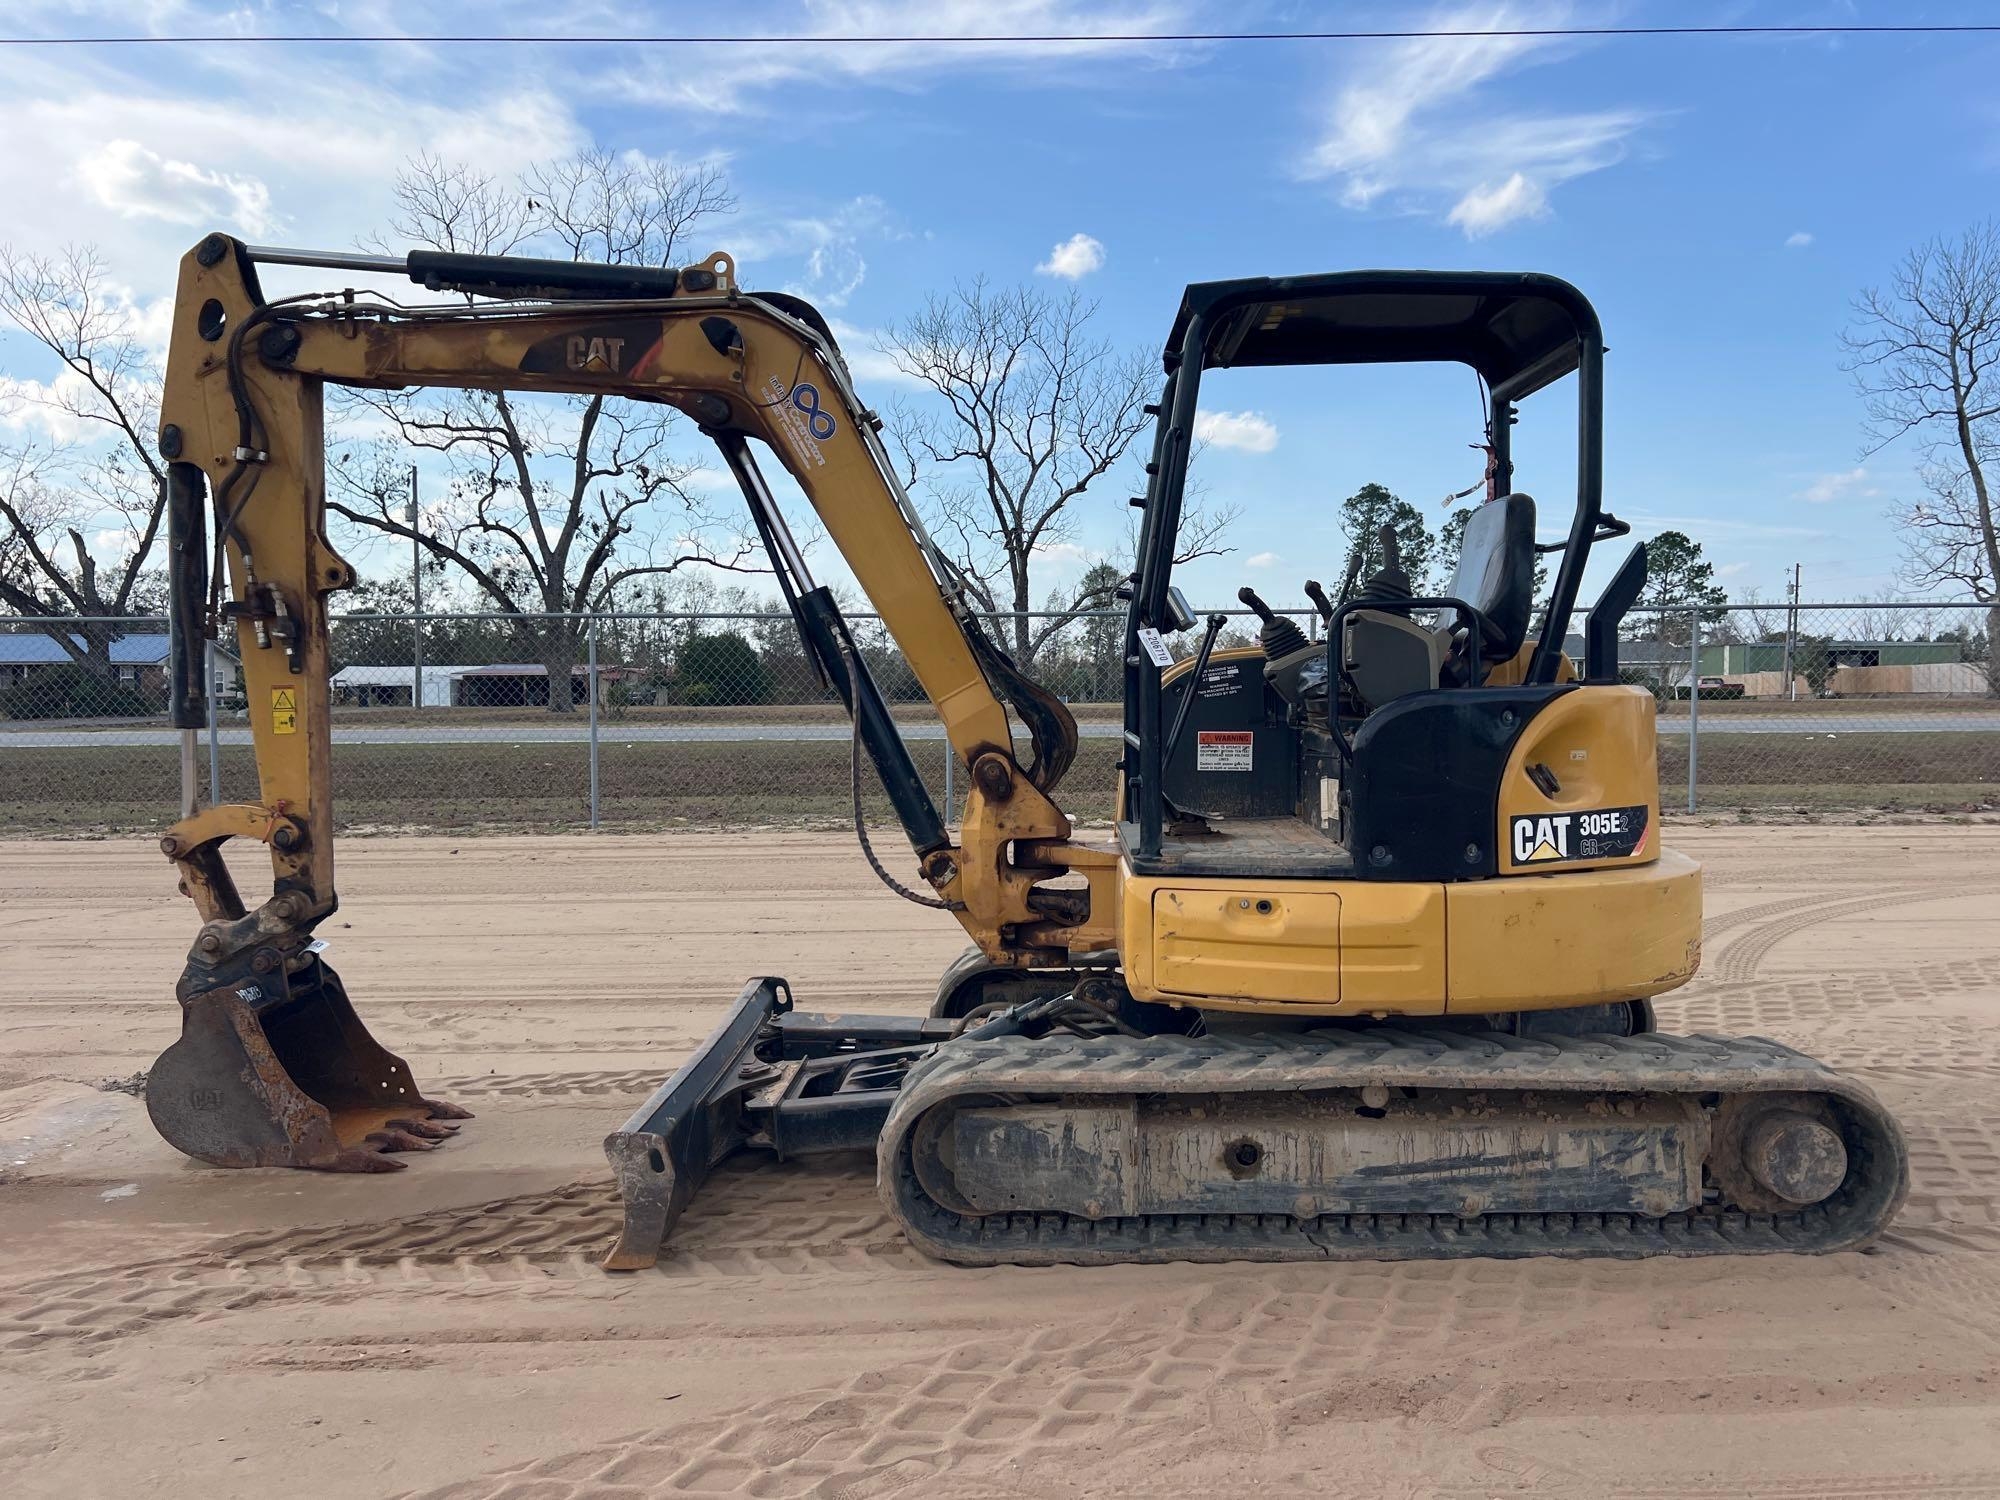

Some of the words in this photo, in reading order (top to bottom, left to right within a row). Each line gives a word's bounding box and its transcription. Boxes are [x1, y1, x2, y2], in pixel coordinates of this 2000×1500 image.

[566, 335, 625, 374] CAT
[1147, 636, 1169, 661] 206710
[1514, 816, 1571, 862] CAT
[1579, 811, 1629, 837] 305E2
[1580, 839, 1599, 856] CR
